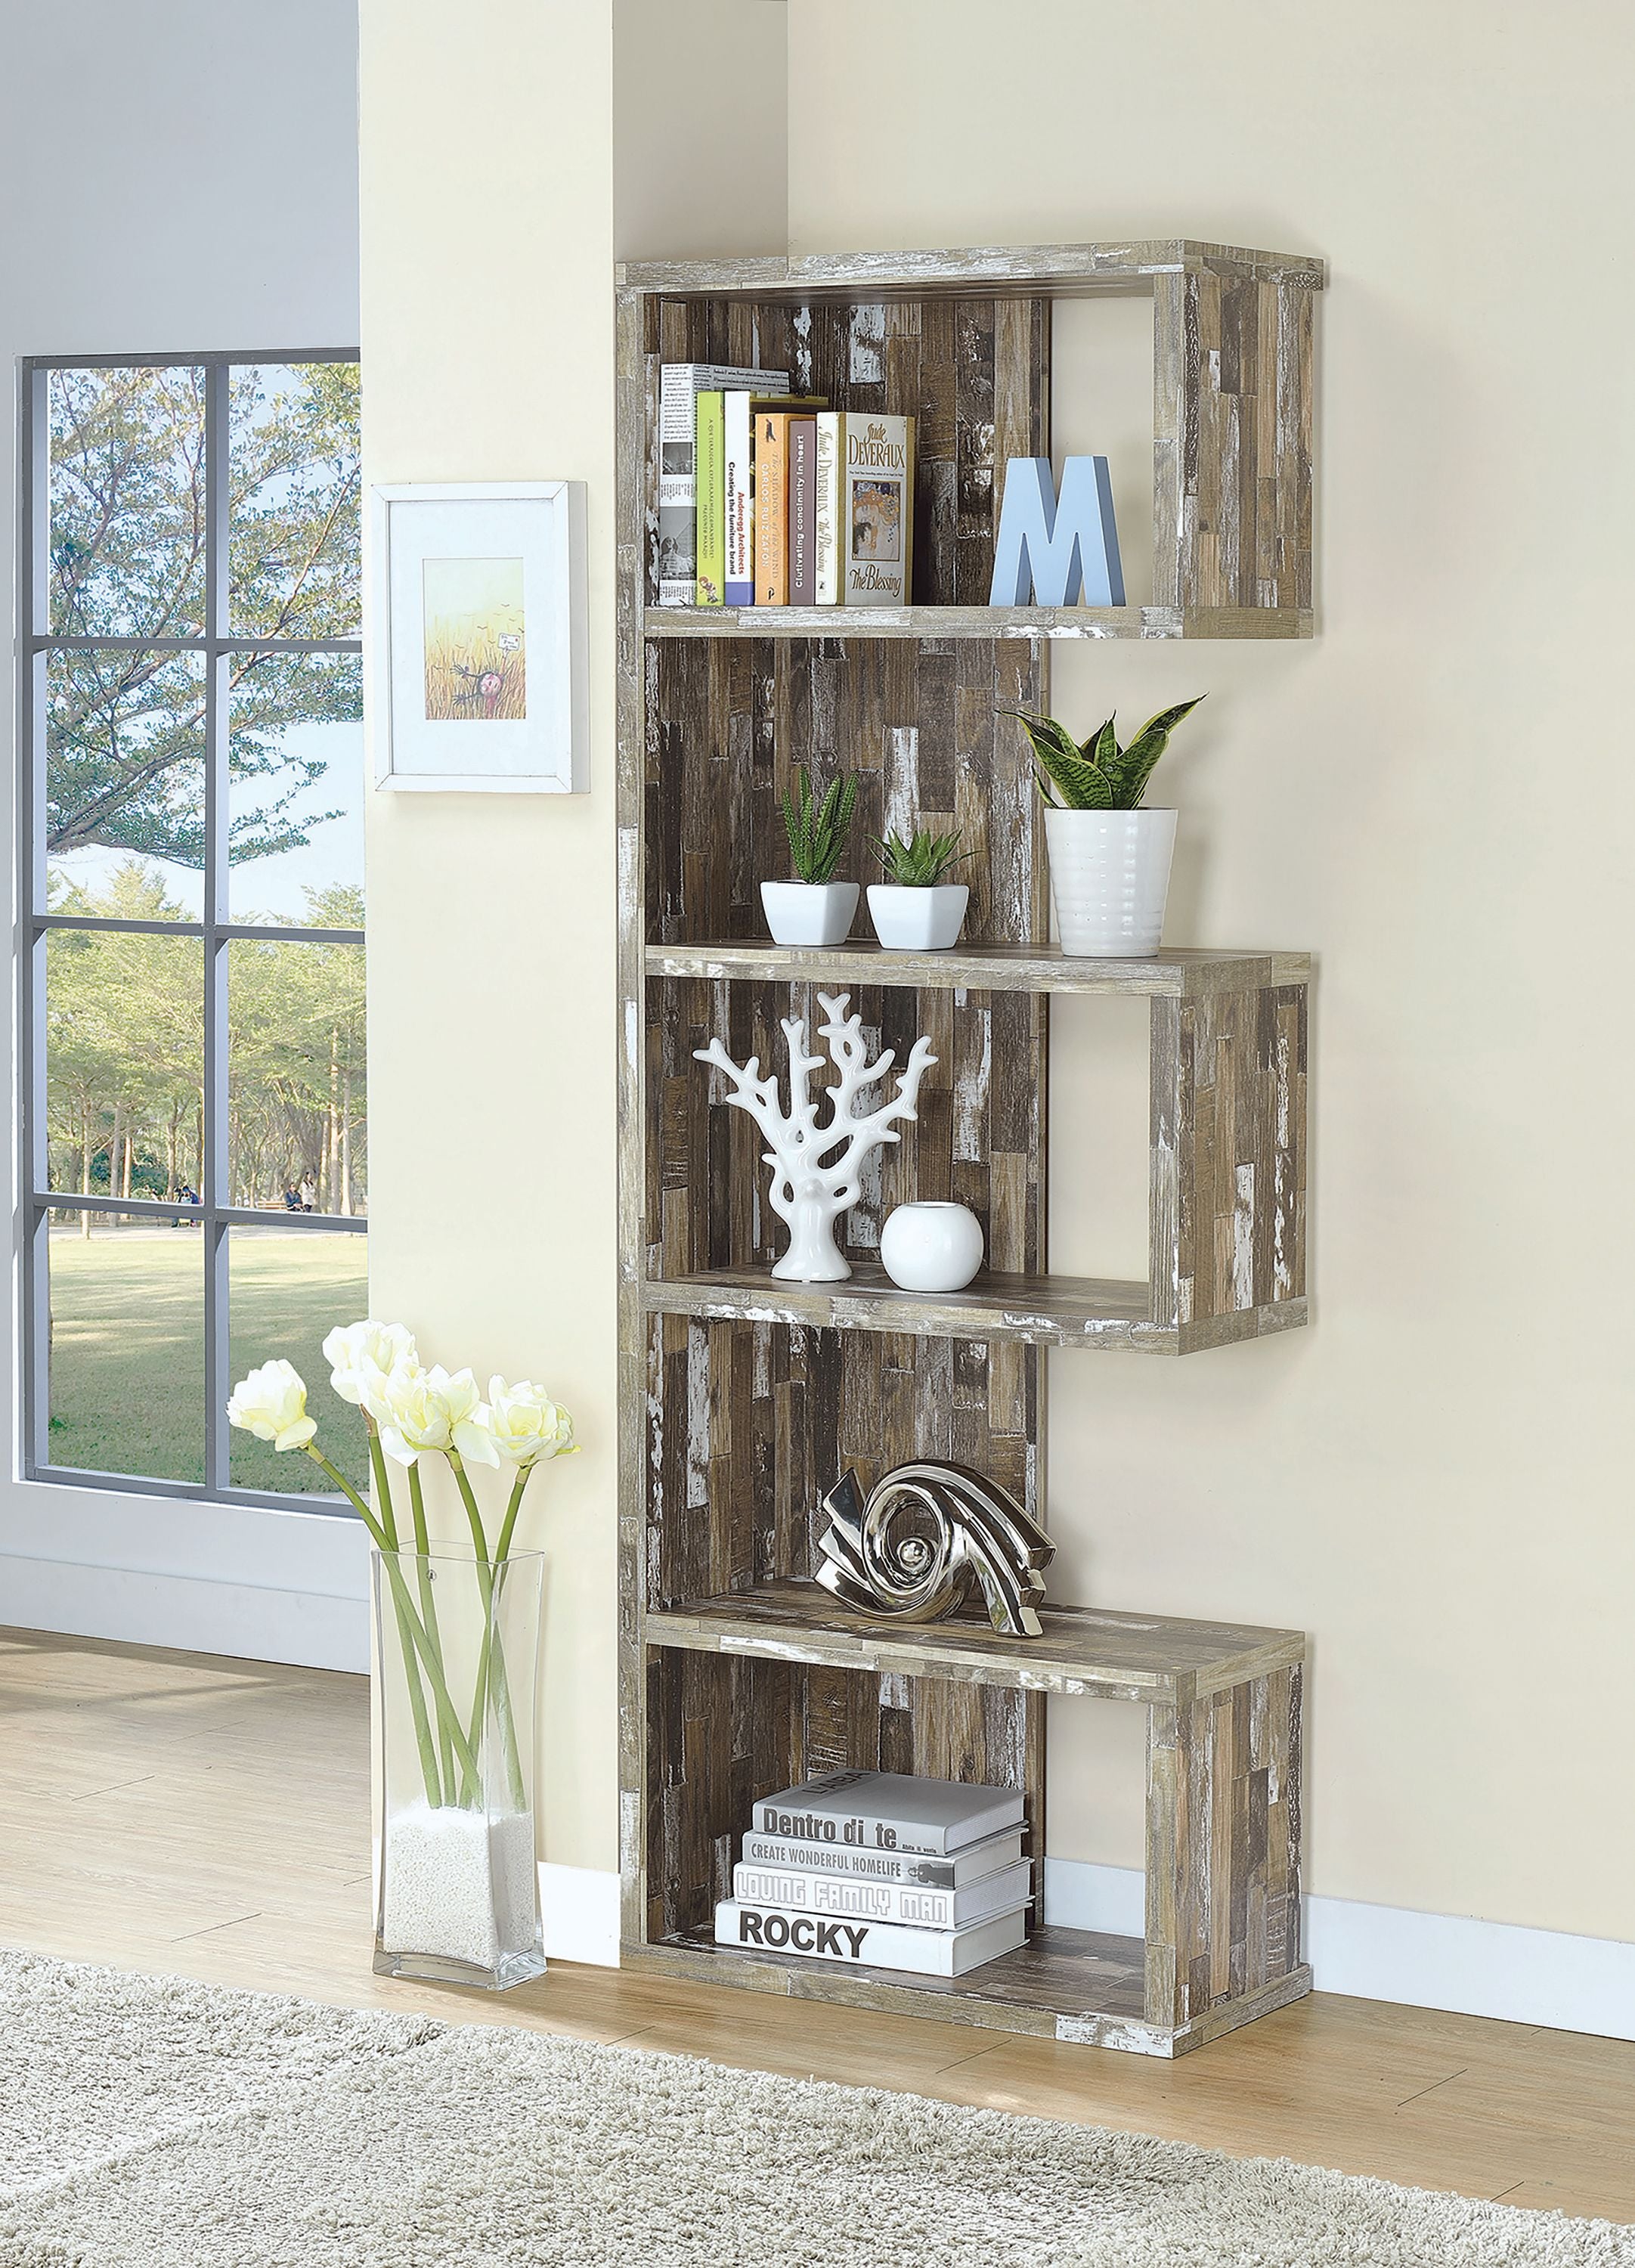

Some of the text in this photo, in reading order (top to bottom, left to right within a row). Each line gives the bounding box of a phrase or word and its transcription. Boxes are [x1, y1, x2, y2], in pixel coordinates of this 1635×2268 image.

[818, 426, 833, 457] Jude
[848, 434, 905, 470] DEVERAUX
[863, 423, 887, 444] Jude
[728, 462, 736, 497] Creating
[761, 463, 770, 503] CARLOS
[817, 459, 832, 513] DEVERAUX
[736, 491, 745, 575] Anderegg Architects
[761, 507, 770, 531] RUIZ
[818, 518, 830, 534] The
[989, 456, 1126, 607] M
[816, 534, 832, 572] Blessing
[849, 564, 902, 597] The Blessing
[763, 1807, 836, 1842] Dentro
[844, 1818, 864, 1845] di
[875, 1823, 896, 1848] te
[751, 1843, 901, 1877] CREATE WONDERFUL HOMELIFE
[736, 1871, 947, 1924] LOVING FAMILY MAN
[739, 1910, 869, 1959] ROCKY
